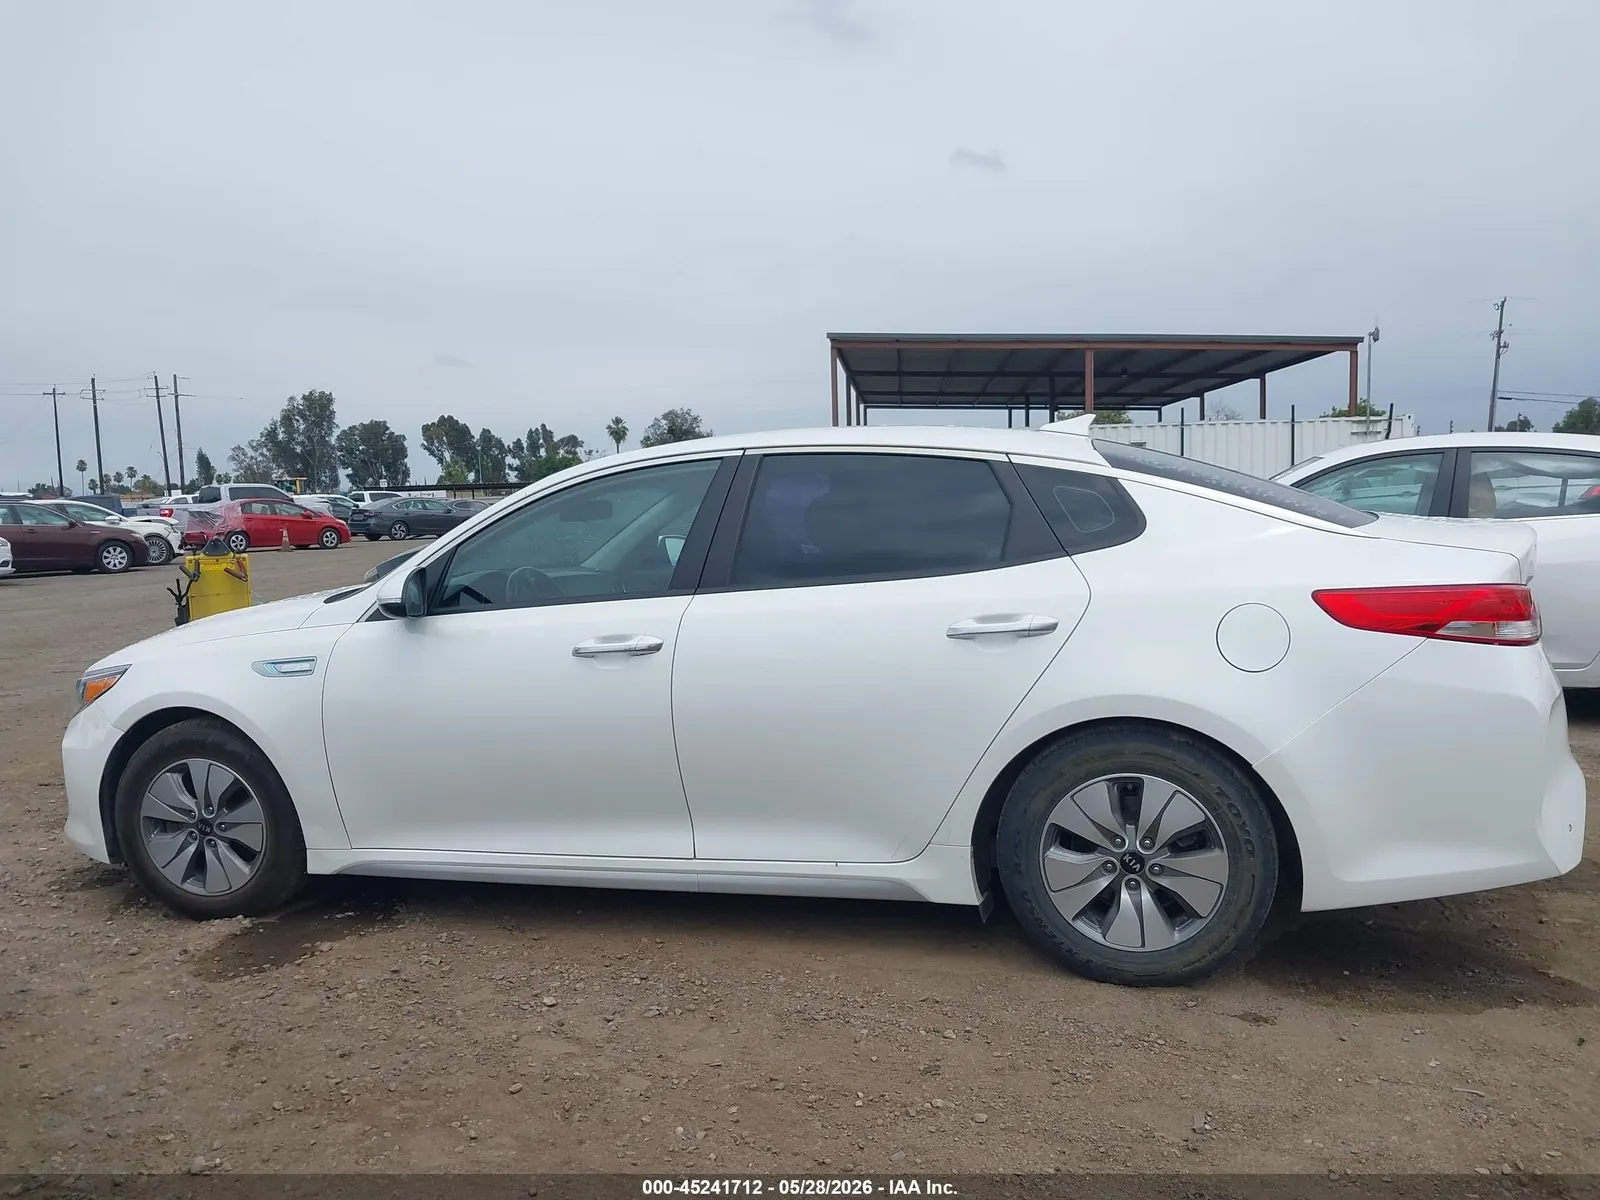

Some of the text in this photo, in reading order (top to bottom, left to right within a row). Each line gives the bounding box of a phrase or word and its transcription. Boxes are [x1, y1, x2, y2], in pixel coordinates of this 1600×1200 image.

[198, 821, 211, 833] KIA
[1213, 785, 1256, 859] TOYO
[1122, 853, 1141, 872] KIA
